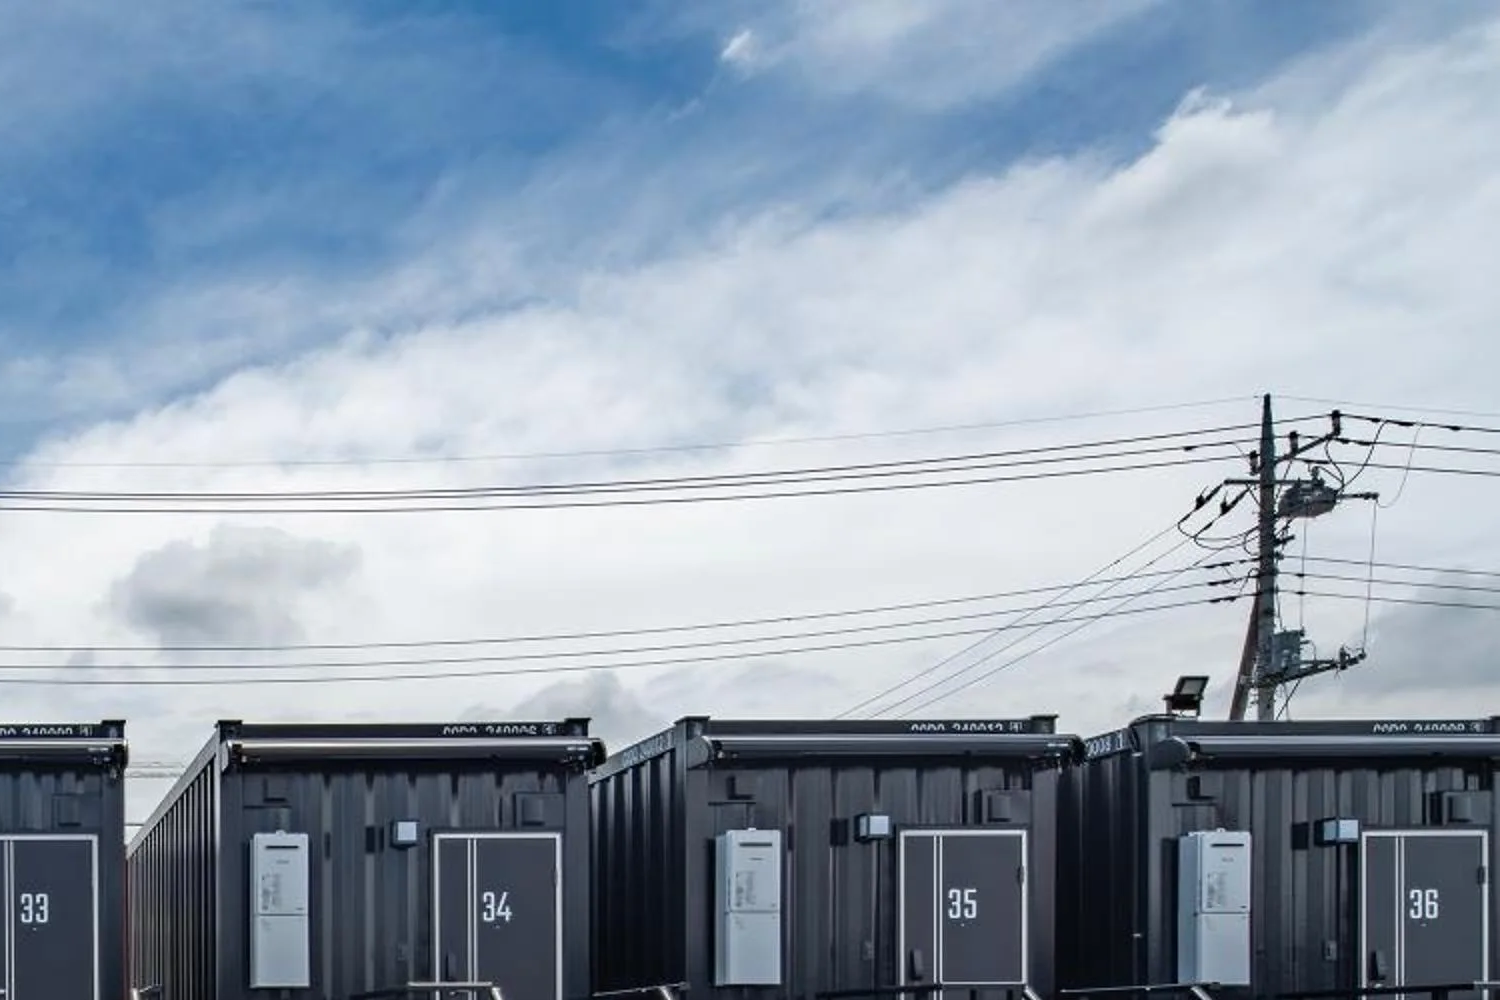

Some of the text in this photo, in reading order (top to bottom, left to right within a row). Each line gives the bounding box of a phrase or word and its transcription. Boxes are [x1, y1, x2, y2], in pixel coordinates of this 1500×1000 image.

[20, 893, 49, 923] 33
[482, 891, 513, 922] 34
[947, 888, 977, 919] 35
[1409, 888, 1439, 920] 36
